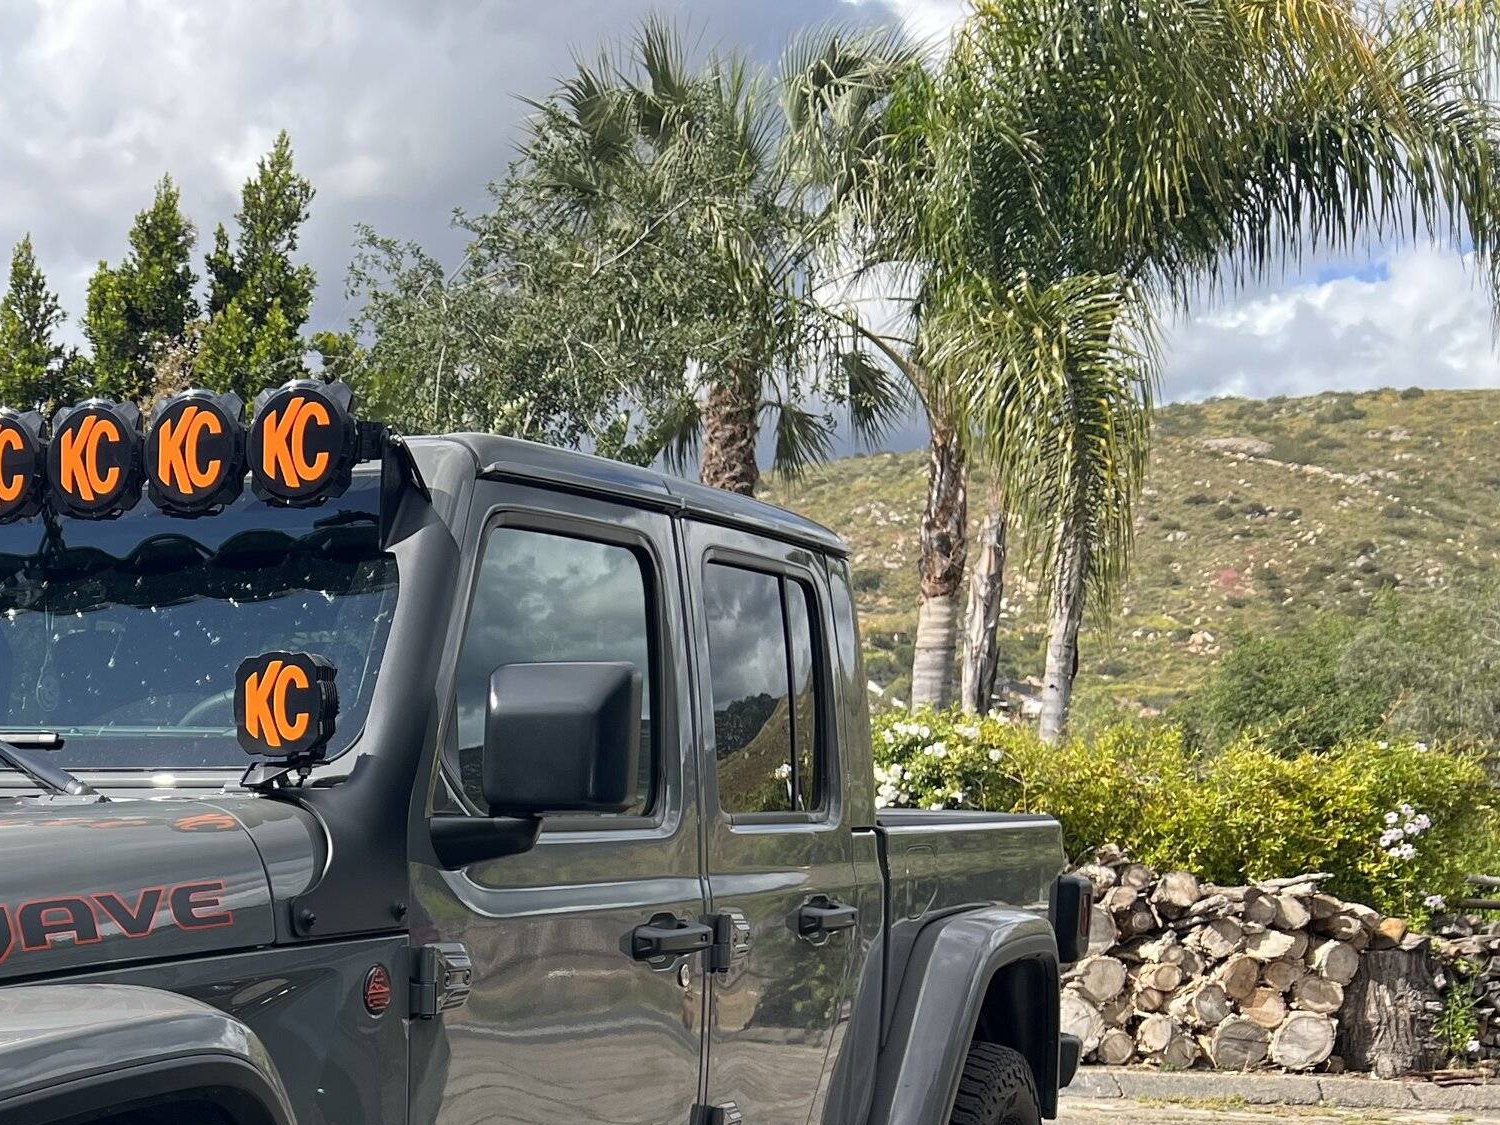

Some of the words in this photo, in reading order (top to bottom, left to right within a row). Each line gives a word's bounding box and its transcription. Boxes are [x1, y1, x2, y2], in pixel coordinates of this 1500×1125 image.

[62, 416, 118, 500] KC
[159, 407, 221, 493] KC
[264, 398, 329, 487] KC
[246, 661, 310, 747] KC
